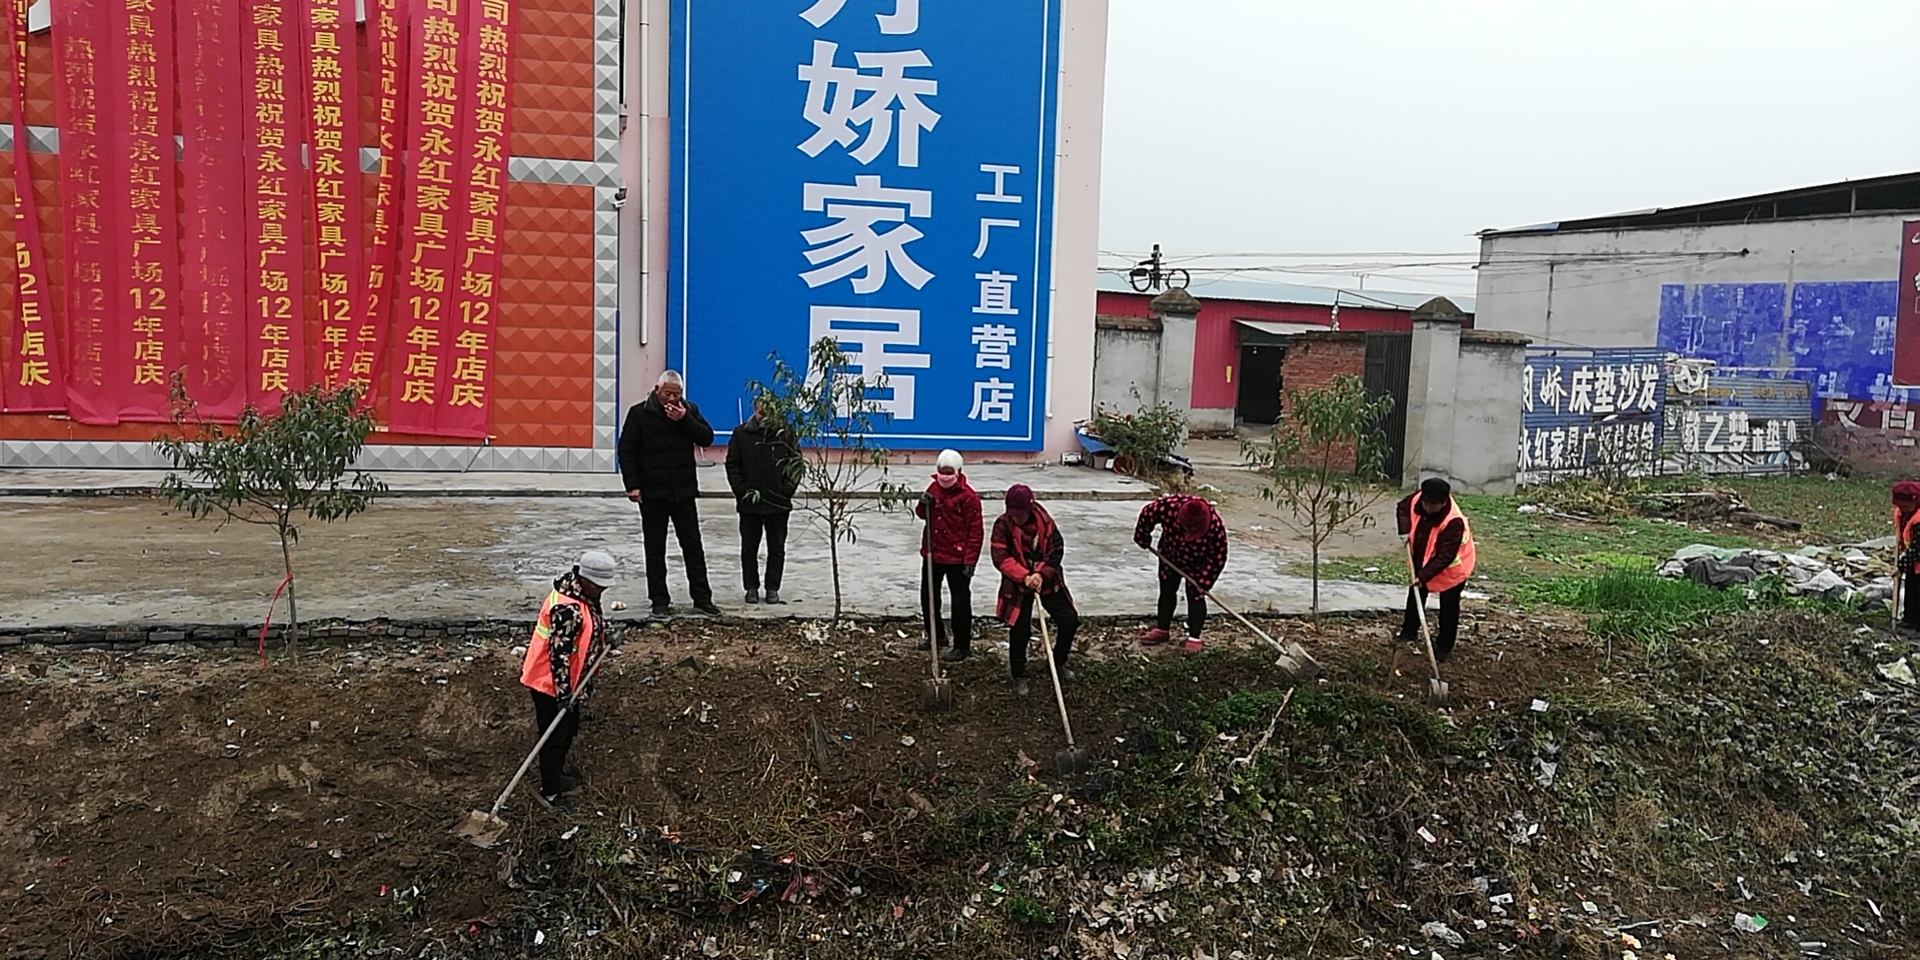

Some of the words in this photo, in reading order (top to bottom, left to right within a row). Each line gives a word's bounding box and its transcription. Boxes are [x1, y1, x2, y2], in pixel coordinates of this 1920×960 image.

[449, 0, 509, 408] 司热烈祝贺永红家具广场12年店庆
[968, 164, 1022, 422] 工厂直营店
